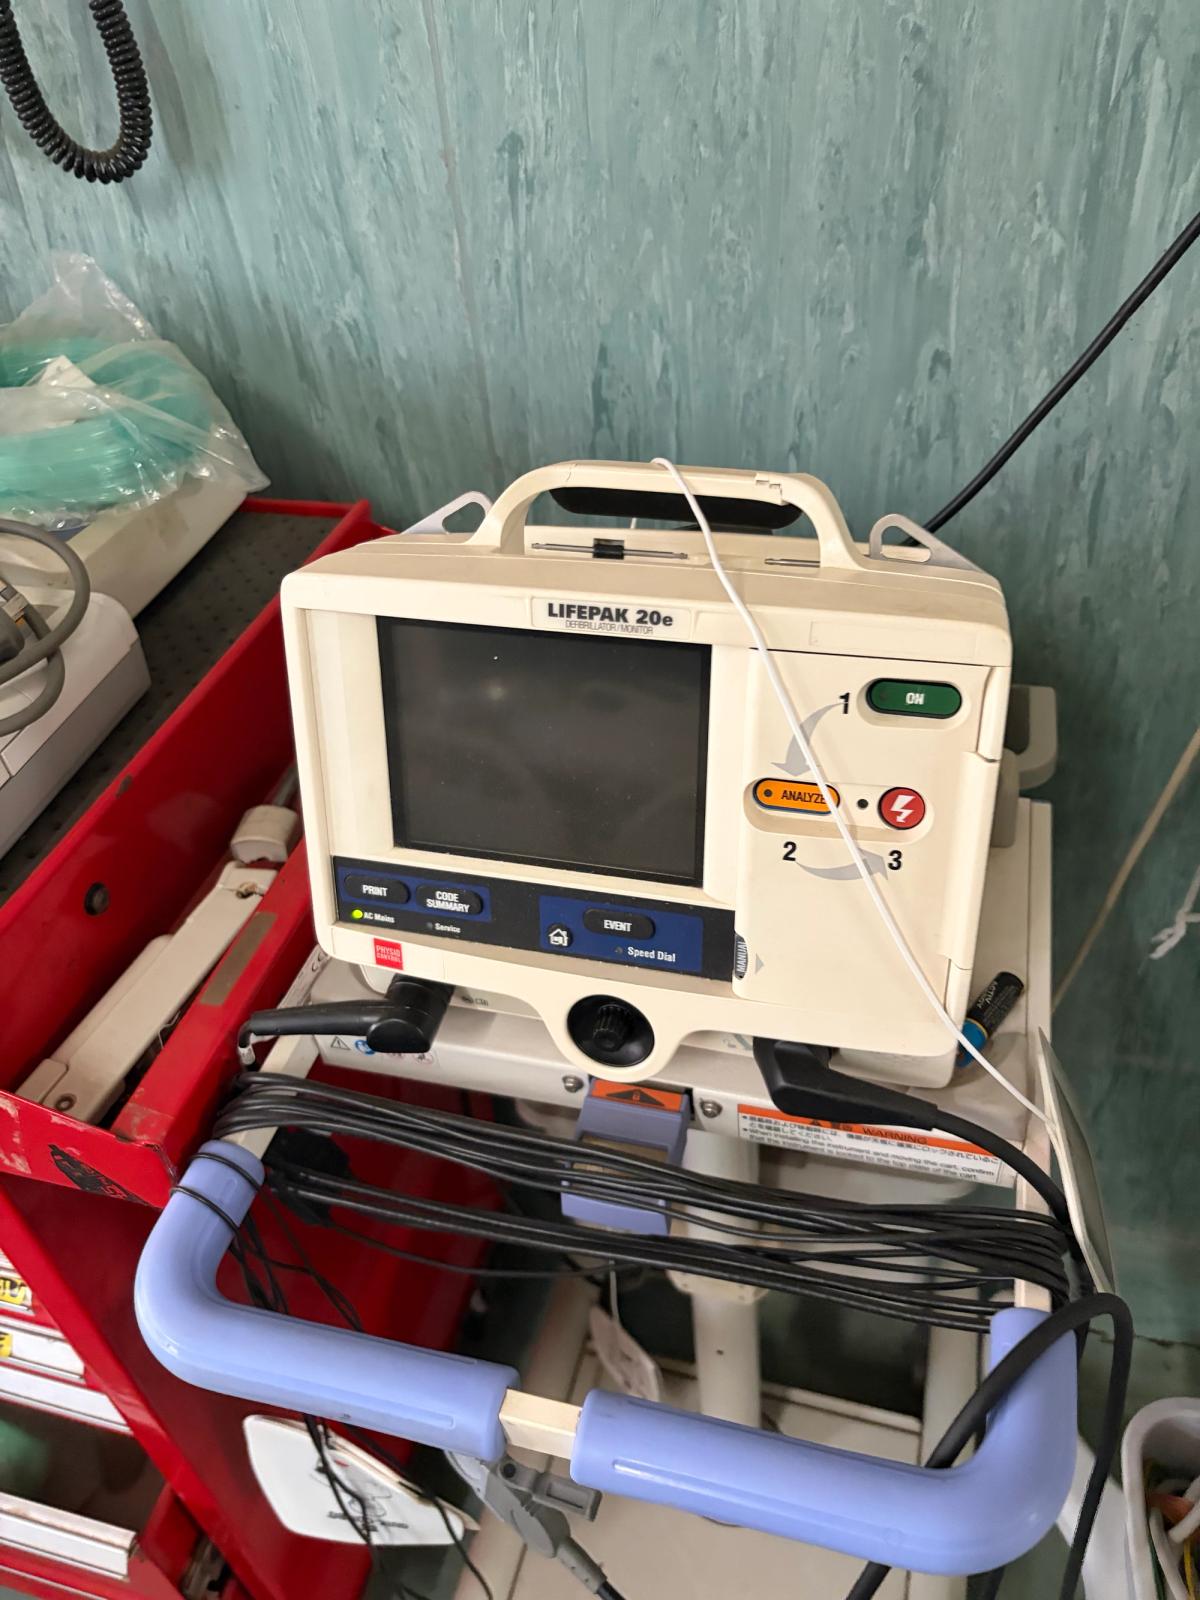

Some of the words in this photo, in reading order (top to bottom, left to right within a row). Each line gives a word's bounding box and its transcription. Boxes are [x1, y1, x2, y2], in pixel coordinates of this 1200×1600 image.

[548, 603, 629, 623] LIFEPAK
[636, 609, 673, 626] 20e
[839, 692, 850, 715] 1
[906, 692, 925, 705] ON
[780, 789, 826, 805] ANALYZE
[782, 841, 797, 862] 2
[887, 850, 902, 870] 3
[362, 884, 388, 897] PRINT
[436, 890, 459, 902] CODE
[426, 899, 470, 913] SUMMARY
[363, 911, 373, 920] AC
[374, 913, 395, 923] Mains
[434, 922, 461, 934] Service
[604, 919, 632, 932] EVENT
[627, 946, 655, 959] Speed
[657, 951, 676, 962] Dial
[737, 941, 748, 973] MANUAL
[863, 1127, 927, 1145] WARNING
